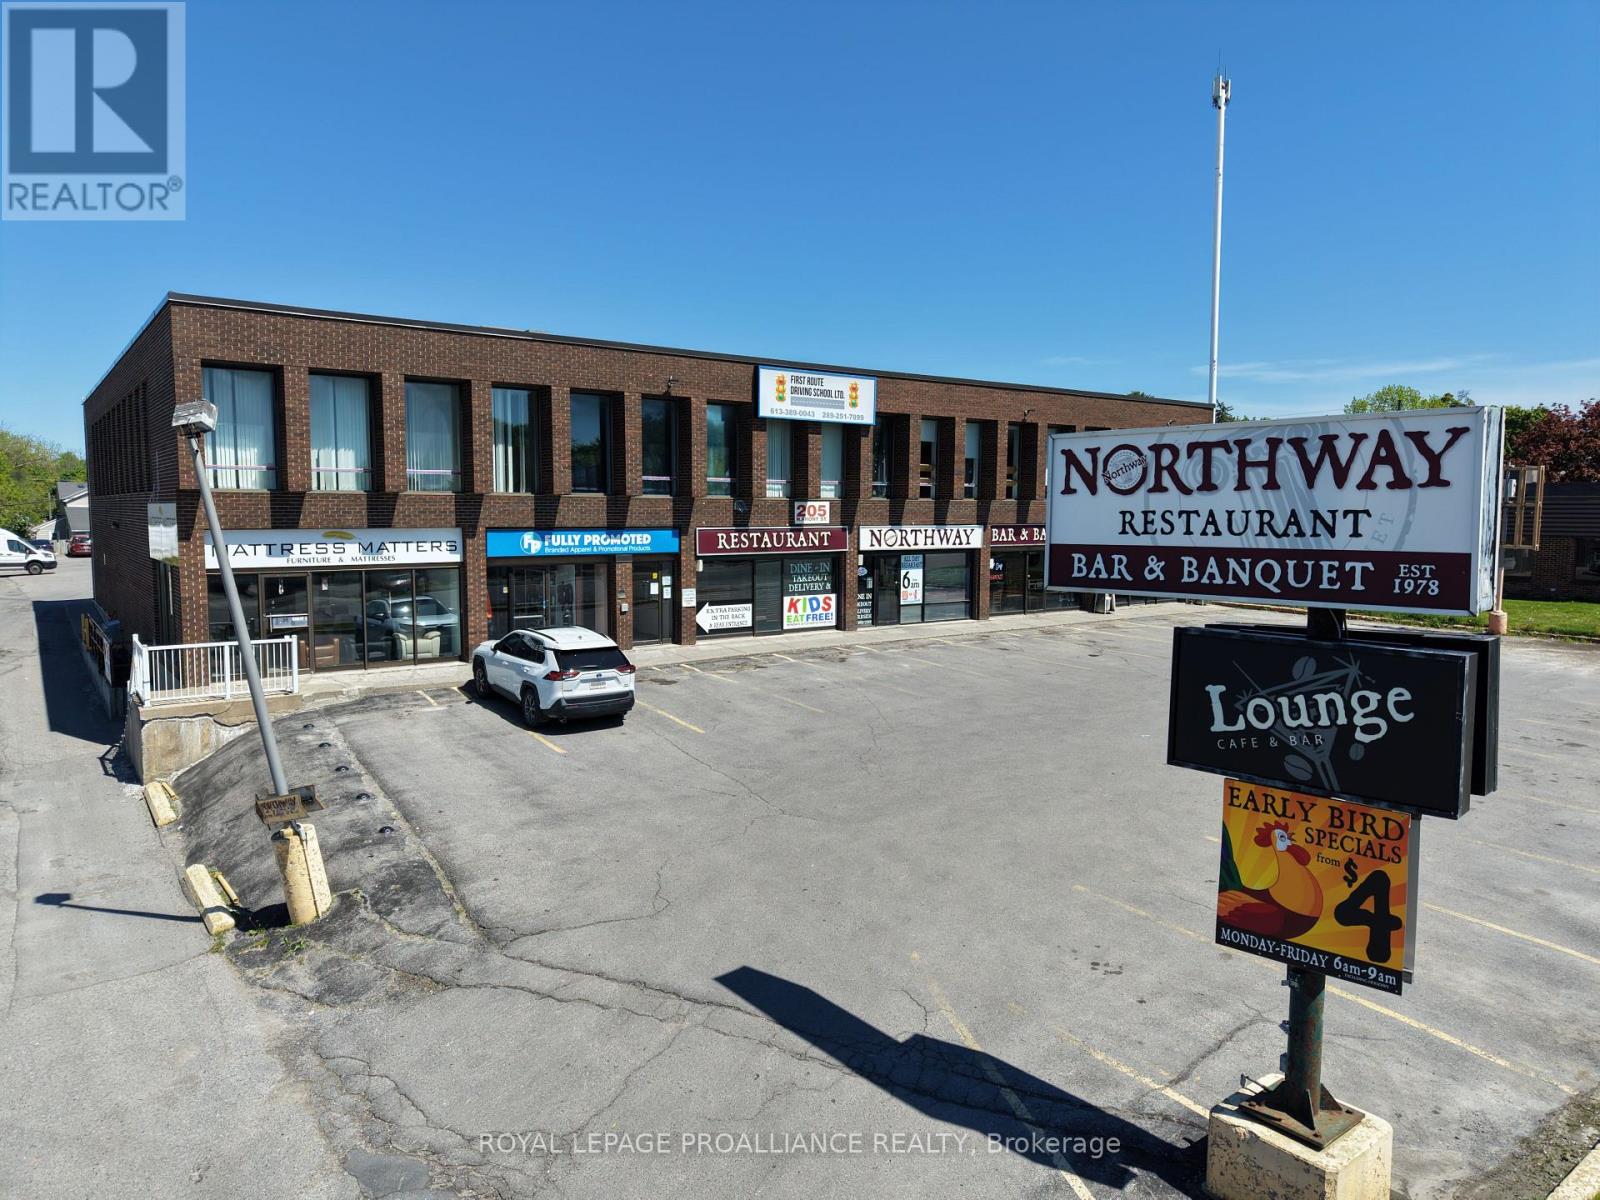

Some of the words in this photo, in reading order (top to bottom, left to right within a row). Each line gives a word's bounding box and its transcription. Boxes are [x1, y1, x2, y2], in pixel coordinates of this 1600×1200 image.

[790, 375, 806, 385] FIRST
[806, 377, 824, 387] ROUTE
[790, 386, 812, 397] DRIVING
[813, 388, 833, 398] SCHOOL
[1061, 427, 1470, 496] NORTHWAY
[1101, 454, 1147, 484] Northway
[796, 504, 827, 517] 205
[1119, 509, 1372, 539] RESTAURANT
[544, 534, 581, 546] FULLY
[583, 533, 652, 546] PROMOTED
[717, 531, 831, 549] RESTAURANT
[869, 528, 975, 547] NORTHWAY
[992, 527, 1015, 542] BAR
[1020, 527, 1028, 542] &
[358, 540, 458, 554] MATTERS
[569, 546, 591, 554] Apparel
[287, 557, 332, 565] FURNITURE
[351, 555, 396, 563] MATTRESSES
[790, 563, 812, 574] DINE
[1071, 552, 1133, 582] BAR
[1143, 555, 1165, 581] &
[1181, 556, 1374, 594] BANQUET
[1398, 564, 1436, 578] EST
[792, 573, 829, 583] TAKEOUT
[902, 570, 910, 589] 6
[789, 583, 824, 592] DELIVERY
[1393, 578, 1440, 596] 1978
[787, 596, 832, 614] KIDS
[786, 614, 804, 624] EAT
[805, 612, 833, 622] FREE!
[1205, 684, 1415, 743] Lounge
[1217, 736, 1260, 750] CAFE
[1269, 736, 1278, 748] &
[1289, 734, 1324, 747] BAR
[1229, 786, 1318, 823] EARLY
[1328, 805, 1405, 842] BIRD
[1304, 826, 1402, 864] SPECIALS
[1316, 852, 1341, 868] from
[1220, 927, 1329, 969] MONDAY-FRIDAY
[1333, 956, 1397, 986] 6am-9am
